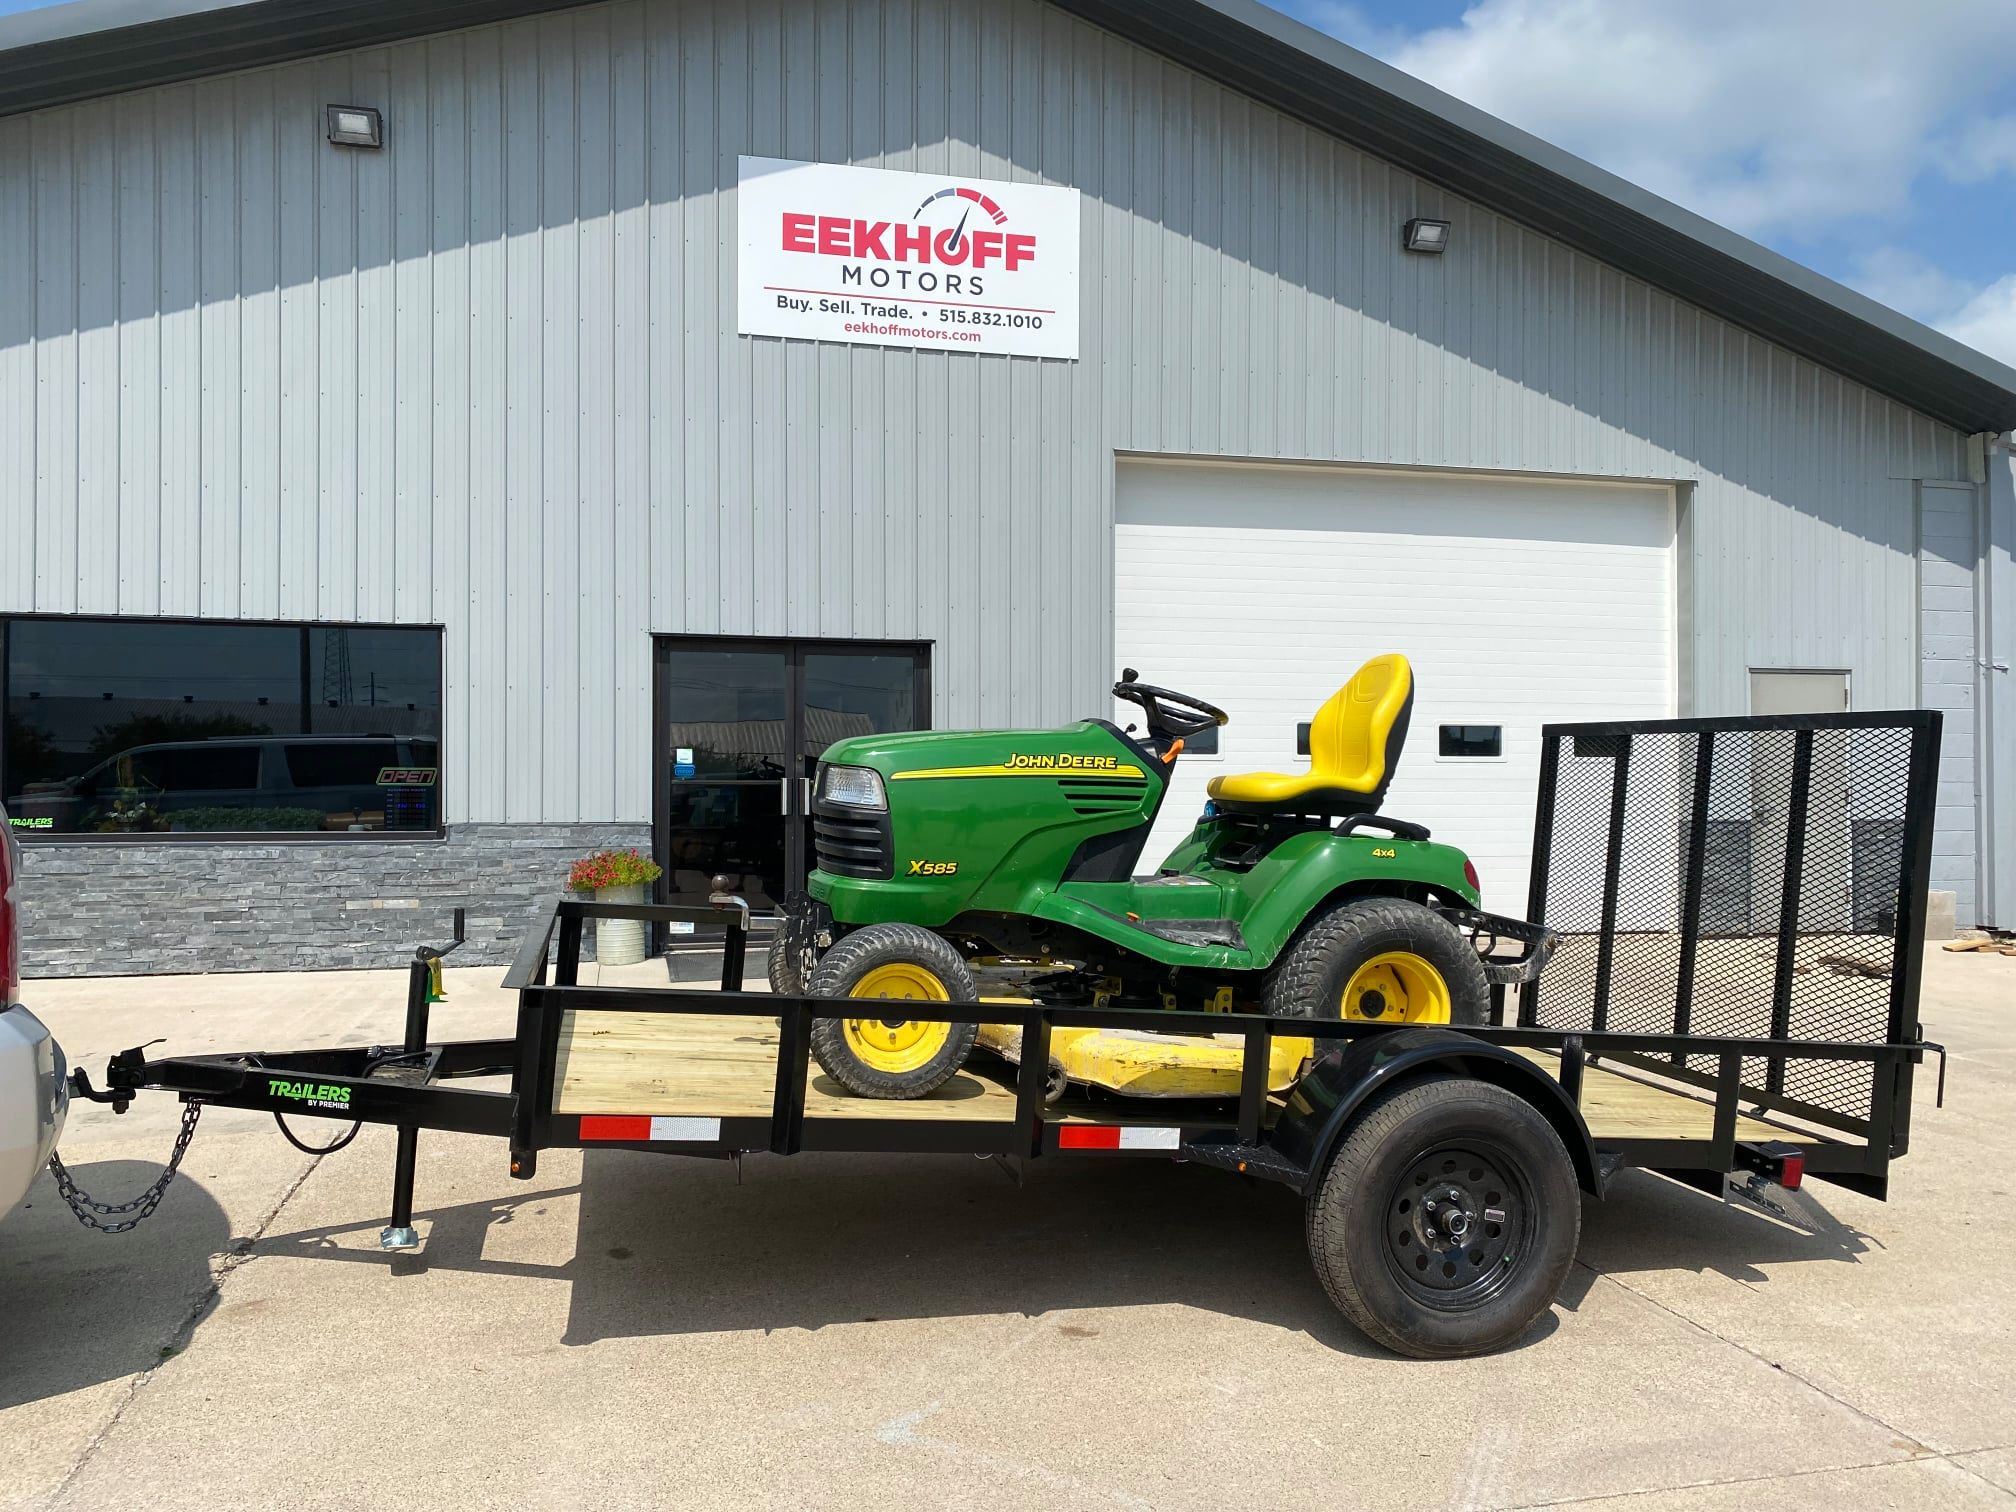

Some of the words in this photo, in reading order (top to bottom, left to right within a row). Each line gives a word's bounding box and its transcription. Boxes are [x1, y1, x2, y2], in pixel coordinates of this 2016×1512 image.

[782, 212, 1036, 271] EEKHOFF
[842, 265, 984, 296] MOTORS
[777, 295, 813, 312] Buy.
[819, 299, 855, 316] Sell.
[861, 303, 913, 320] Trade.
[939, 309, 1042, 330] 515.832.1010
[844, 322, 982, 343] eekhoffmotors.com
[1004, 753, 1055, 768] JOHN
[1058, 753, 1117, 769] DEERE
[380, 770, 434, 783] OPEN
[8, 817, 53, 826] TRAILERS
[1372, 848, 1396, 858] 4x4
[907, 860, 957, 875] X585
[268, 1080, 352, 1103] TRAILERS
[307, 1099, 318, 1107] BY
[318, 1100, 350, 1110] PREMIER
